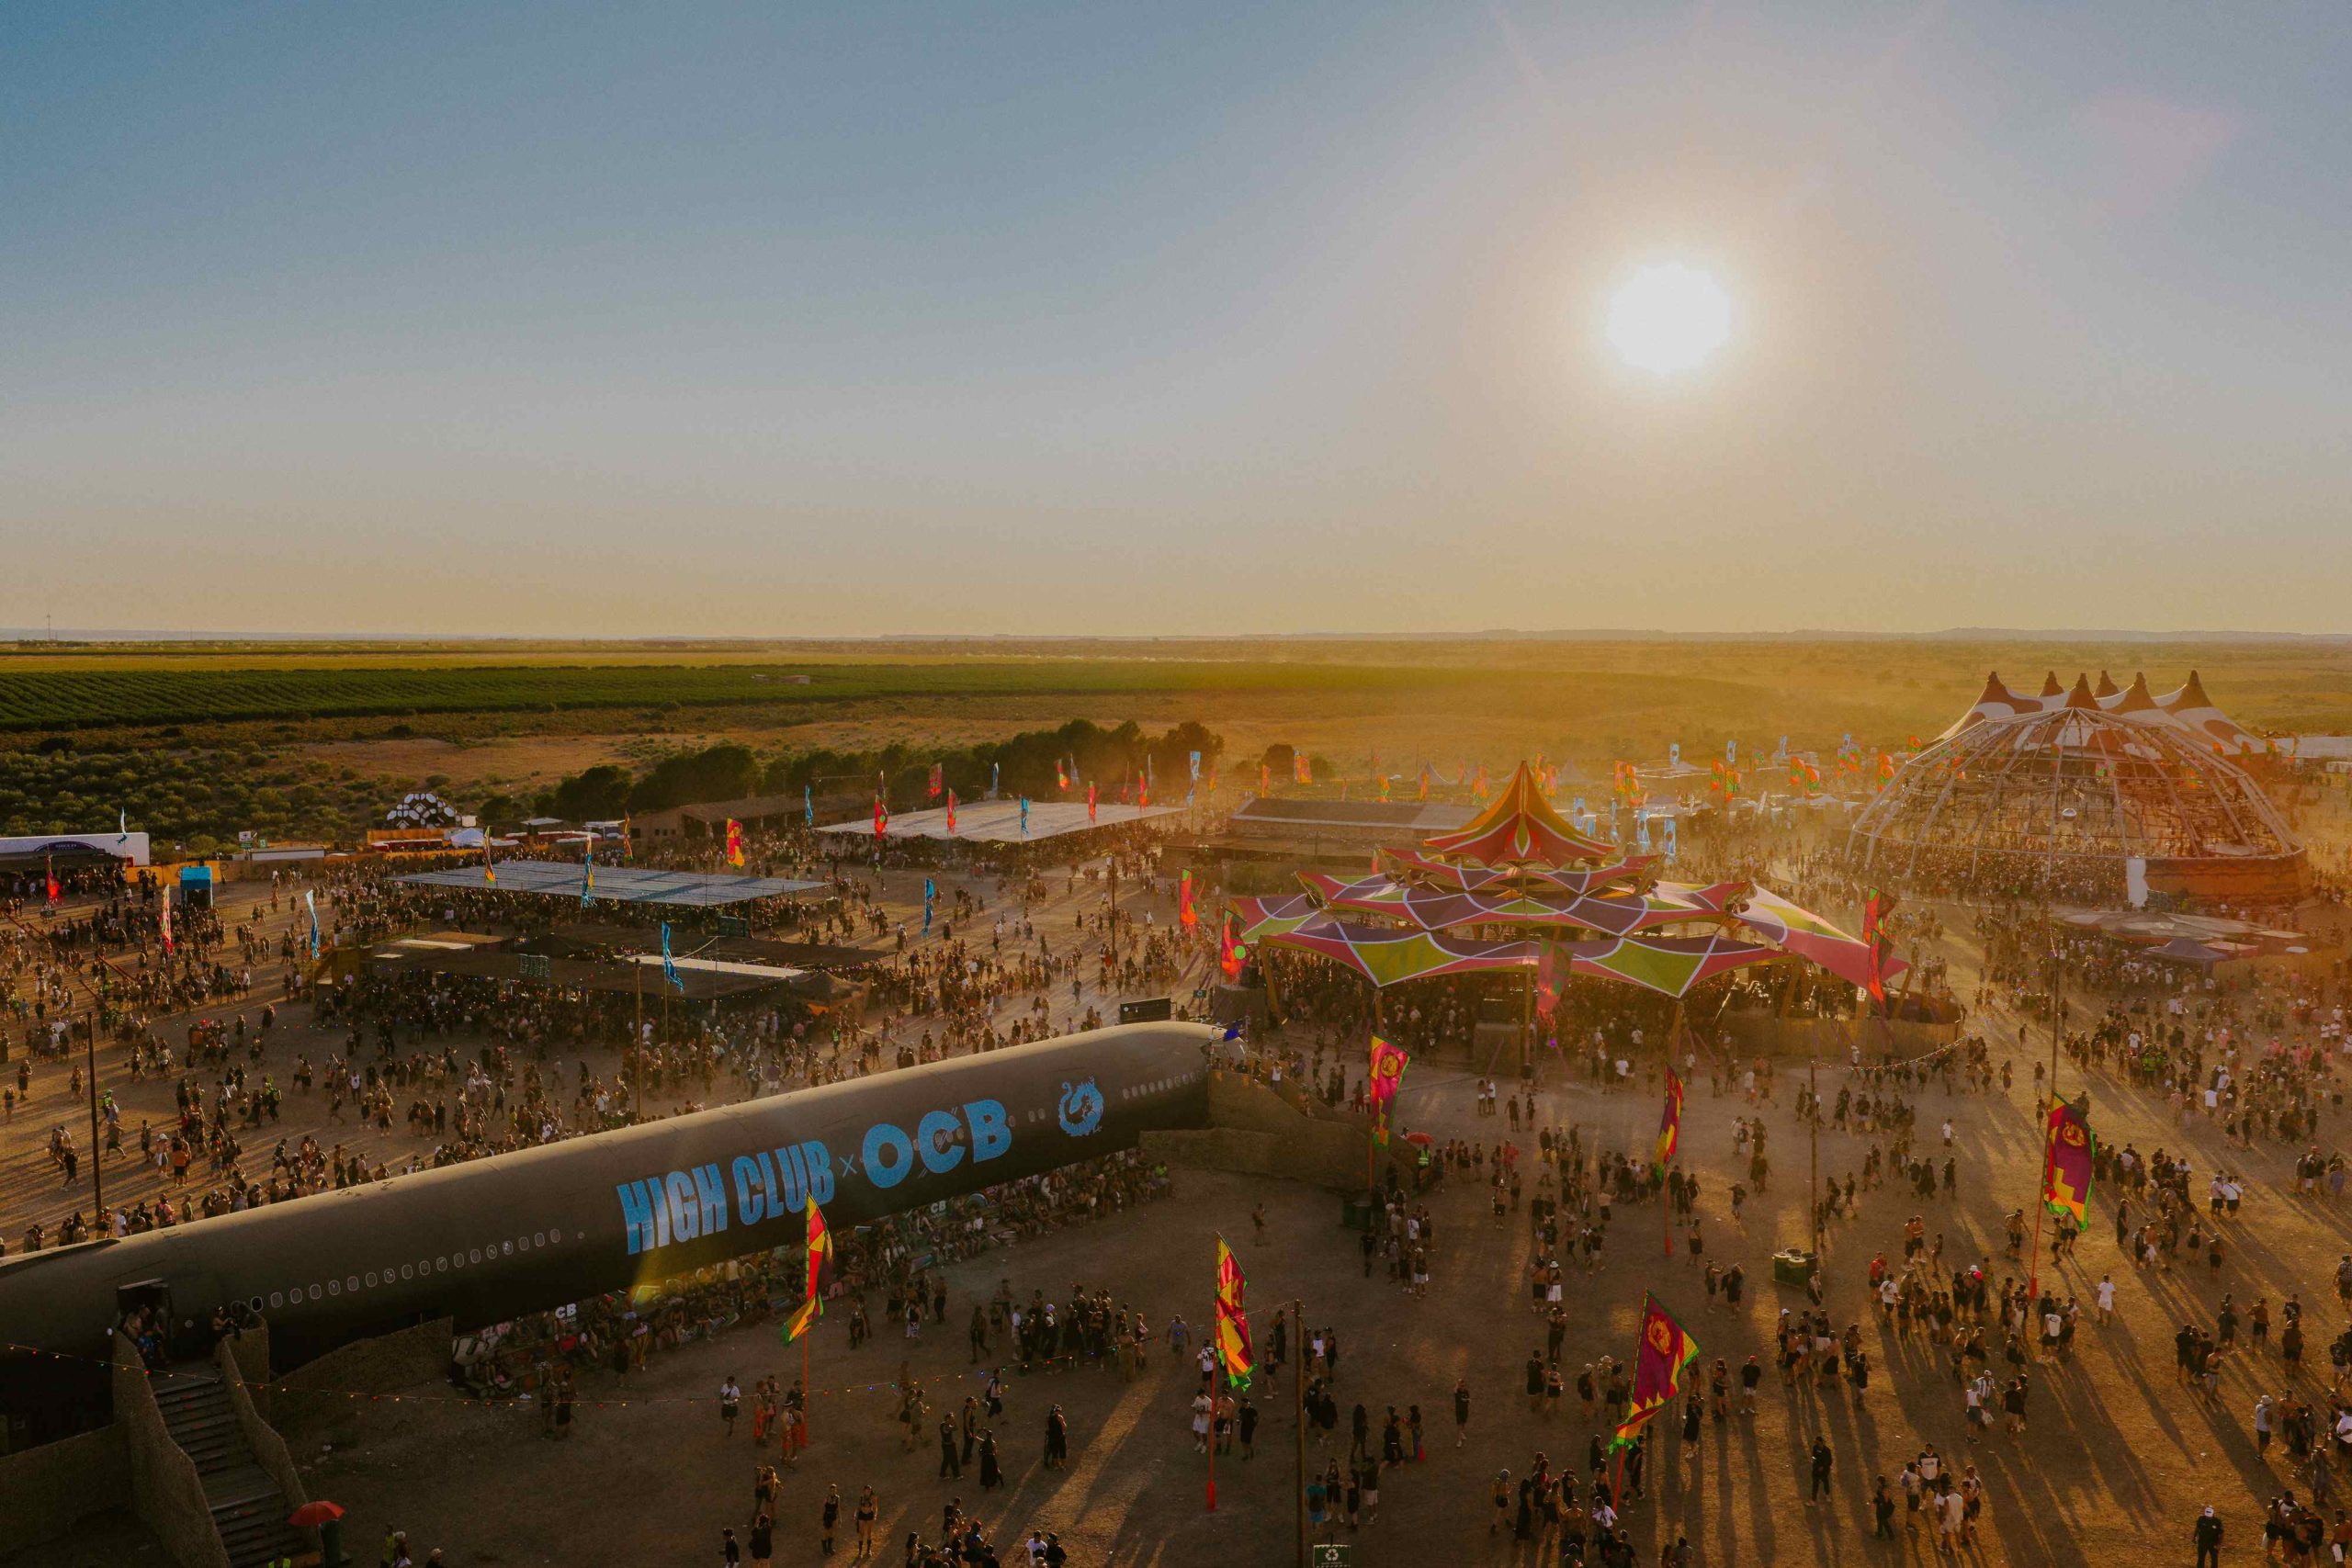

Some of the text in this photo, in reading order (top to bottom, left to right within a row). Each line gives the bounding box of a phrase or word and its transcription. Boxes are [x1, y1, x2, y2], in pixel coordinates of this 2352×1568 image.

[616, 1162, 729, 1256] HIGH
[731, 1140, 835, 1226] CLUB
[862, 1099, 1012, 1189] OCB
